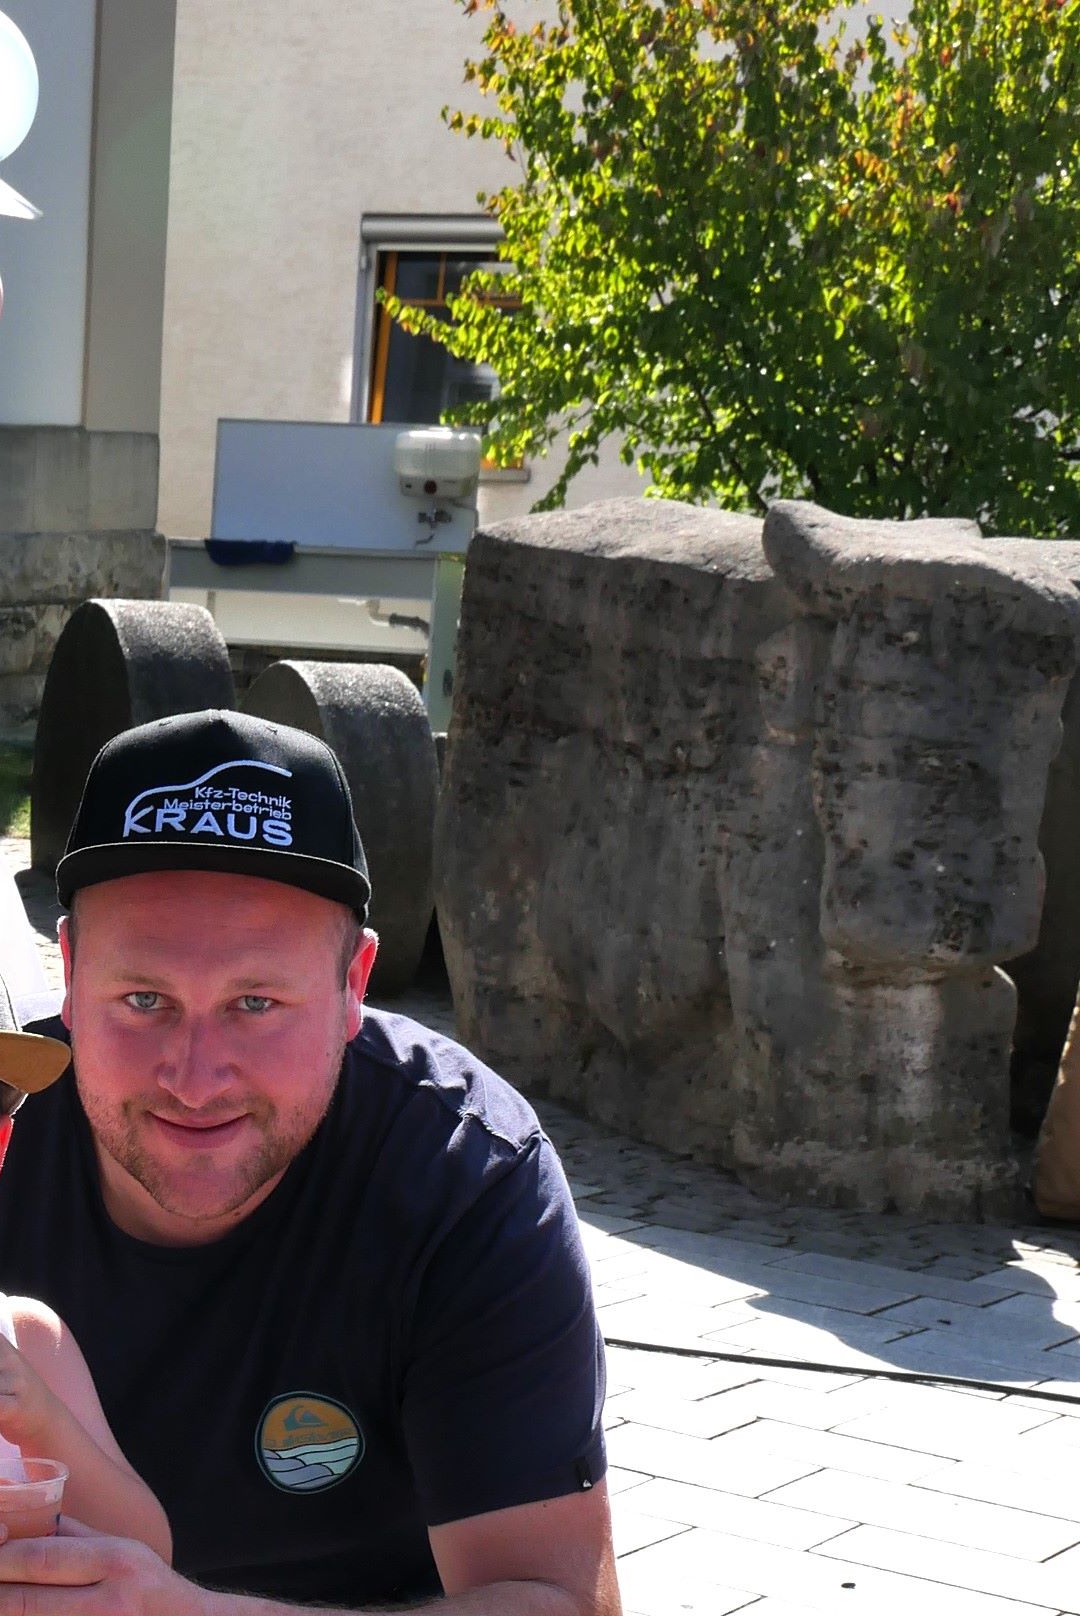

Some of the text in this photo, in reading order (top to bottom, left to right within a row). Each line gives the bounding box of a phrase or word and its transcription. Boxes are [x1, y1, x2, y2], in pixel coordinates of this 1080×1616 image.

[194, 786, 292, 809] Kfz-Technik
[163, 798, 292, 821] Meisterbetrieb
[122, 805, 293, 847] KRAUS
